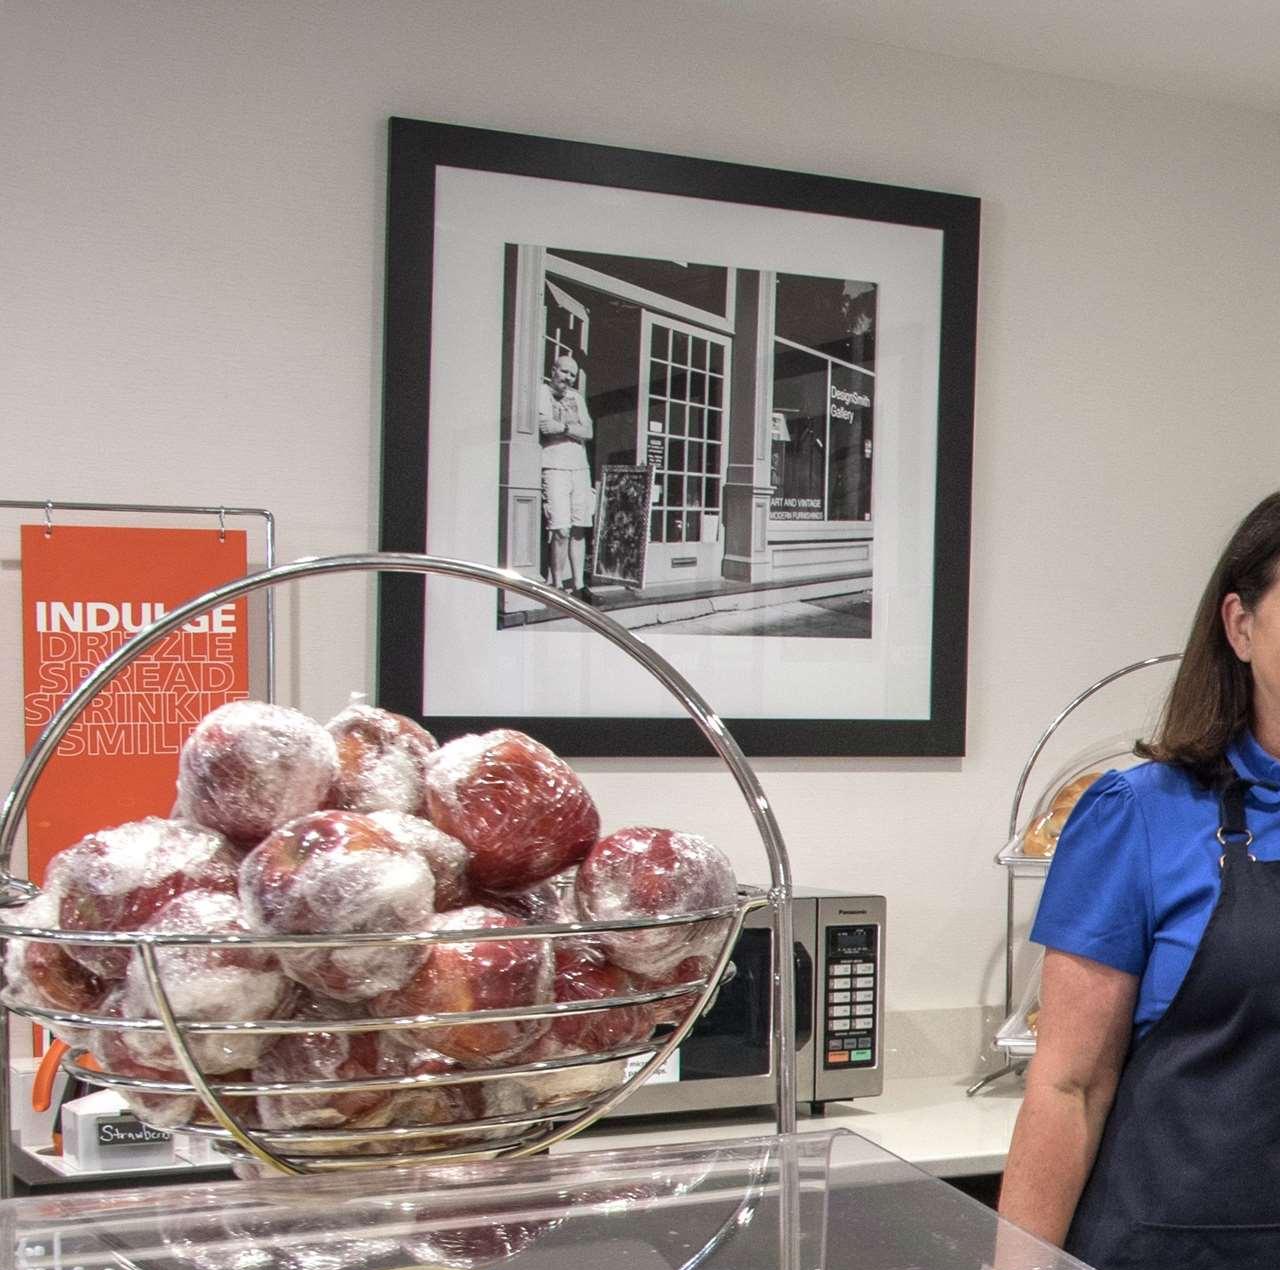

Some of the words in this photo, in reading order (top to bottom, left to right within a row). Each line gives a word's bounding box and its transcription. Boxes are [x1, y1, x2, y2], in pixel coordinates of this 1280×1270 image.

[831, 404, 854, 424] Gallery
[770, 497, 783, 508] ART
[784, 498, 798, 508] AND
[798, 498, 821, 508] VINTAGE
